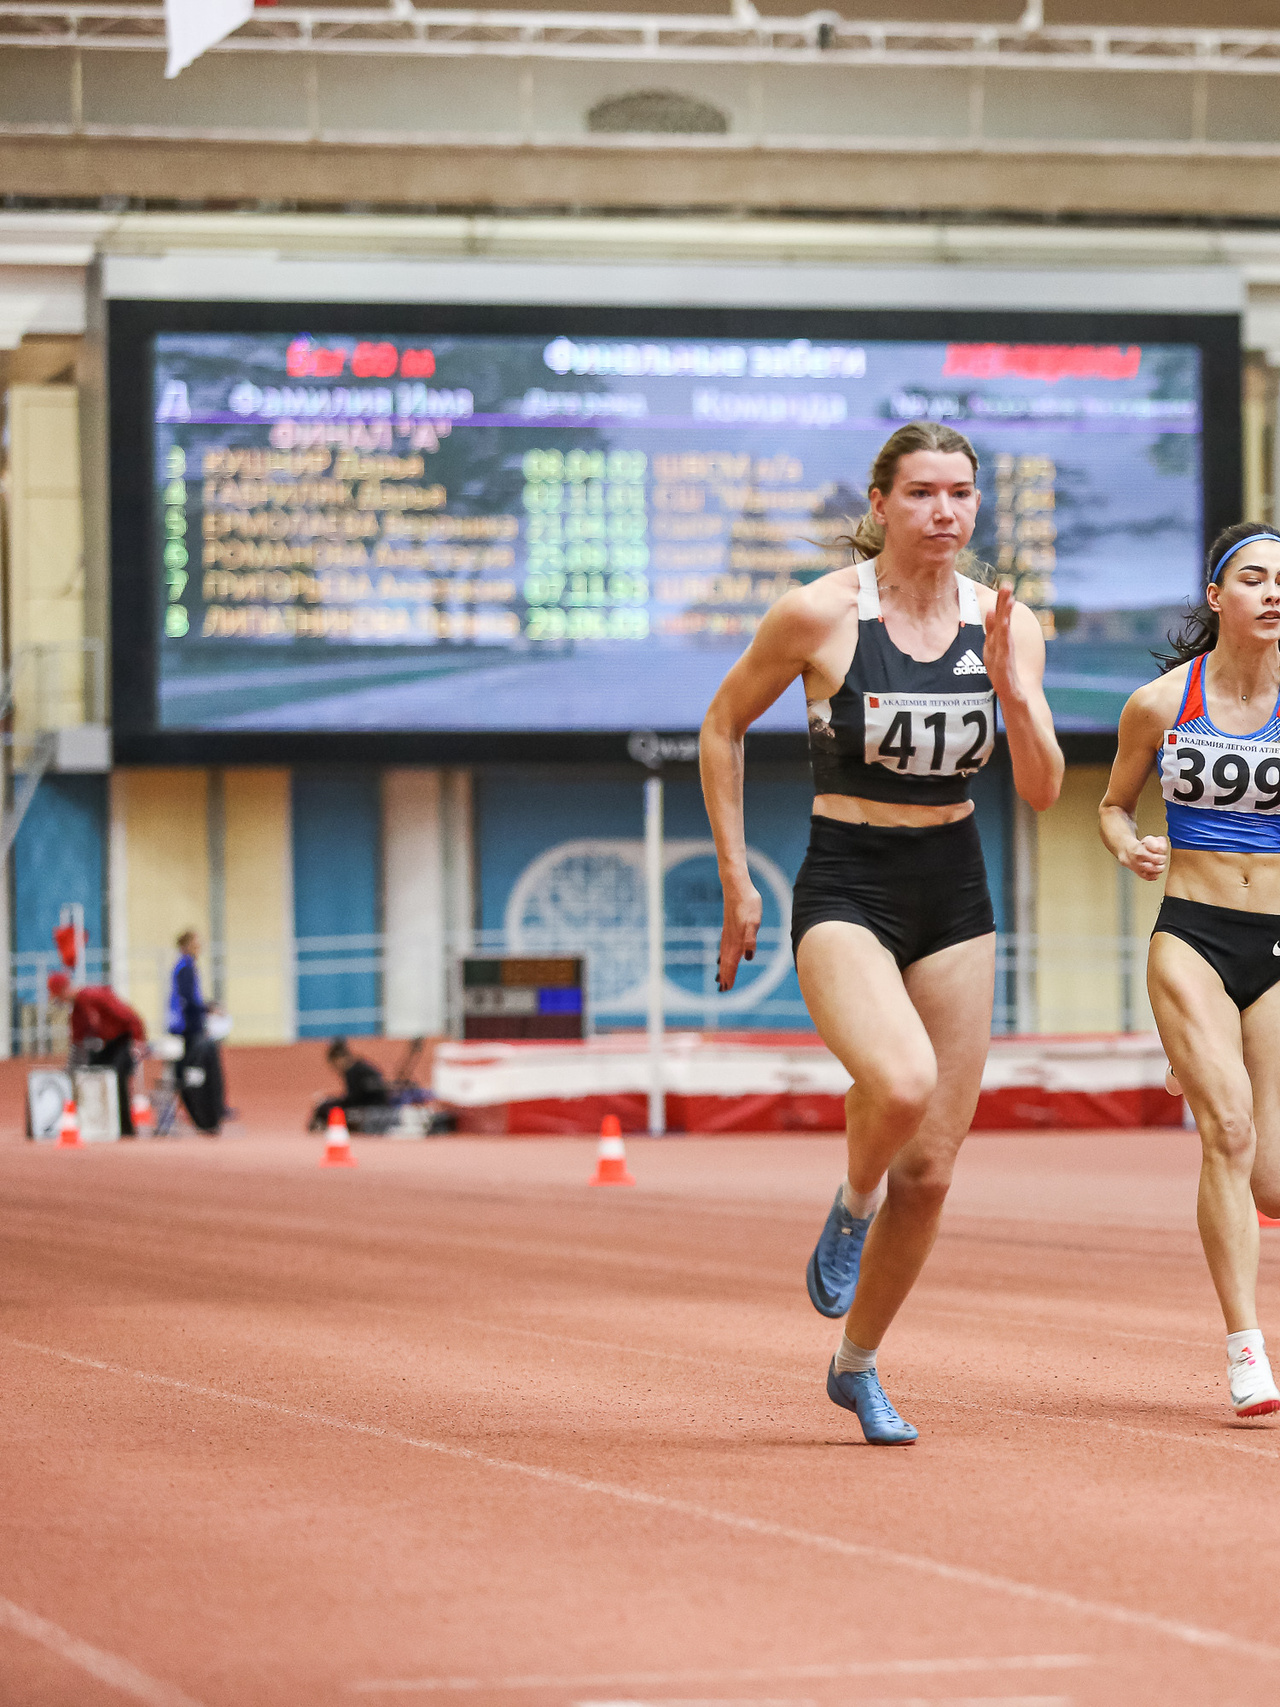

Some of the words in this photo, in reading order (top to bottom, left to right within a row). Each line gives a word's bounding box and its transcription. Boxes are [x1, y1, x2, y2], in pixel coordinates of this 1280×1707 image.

[953, 665, 988, 676] adidas
[882, 699, 927, 707] АКАДЕМИЯ
[929, 699, 960, 707] ЛЕГКОЙ
[878, 710, 987, 770] 412
[1178, 737, 1224, 749] АКАДЕМИЯ
[1225, 743, 1257, 753] ЛЕГКОЙ
